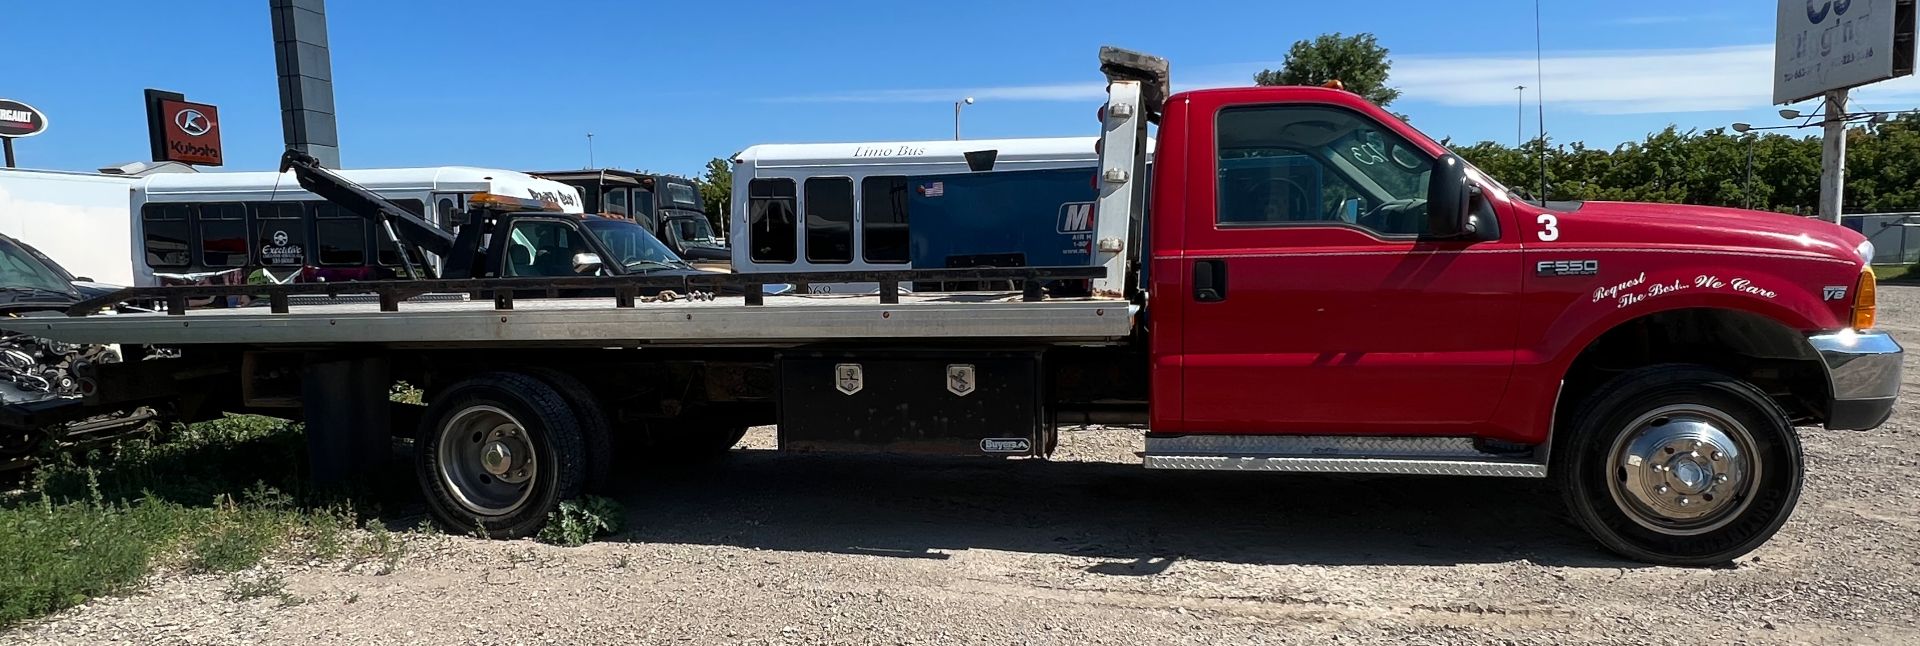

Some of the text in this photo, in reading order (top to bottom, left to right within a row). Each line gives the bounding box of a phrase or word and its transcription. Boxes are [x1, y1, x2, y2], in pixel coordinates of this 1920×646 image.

[171, 141, 218, 158] Kubota
[853, 146, 926, 157] Limo Bus
[1537, 214, 1559, 241] 3
[1592, 272, 1646, 303] Request
[1617, 293, 1647, 309] The
[1694, 274, 1726, 289] We
[1730, 277, 1777, 299] Care
[1823, 290, 1846, 301] V8
